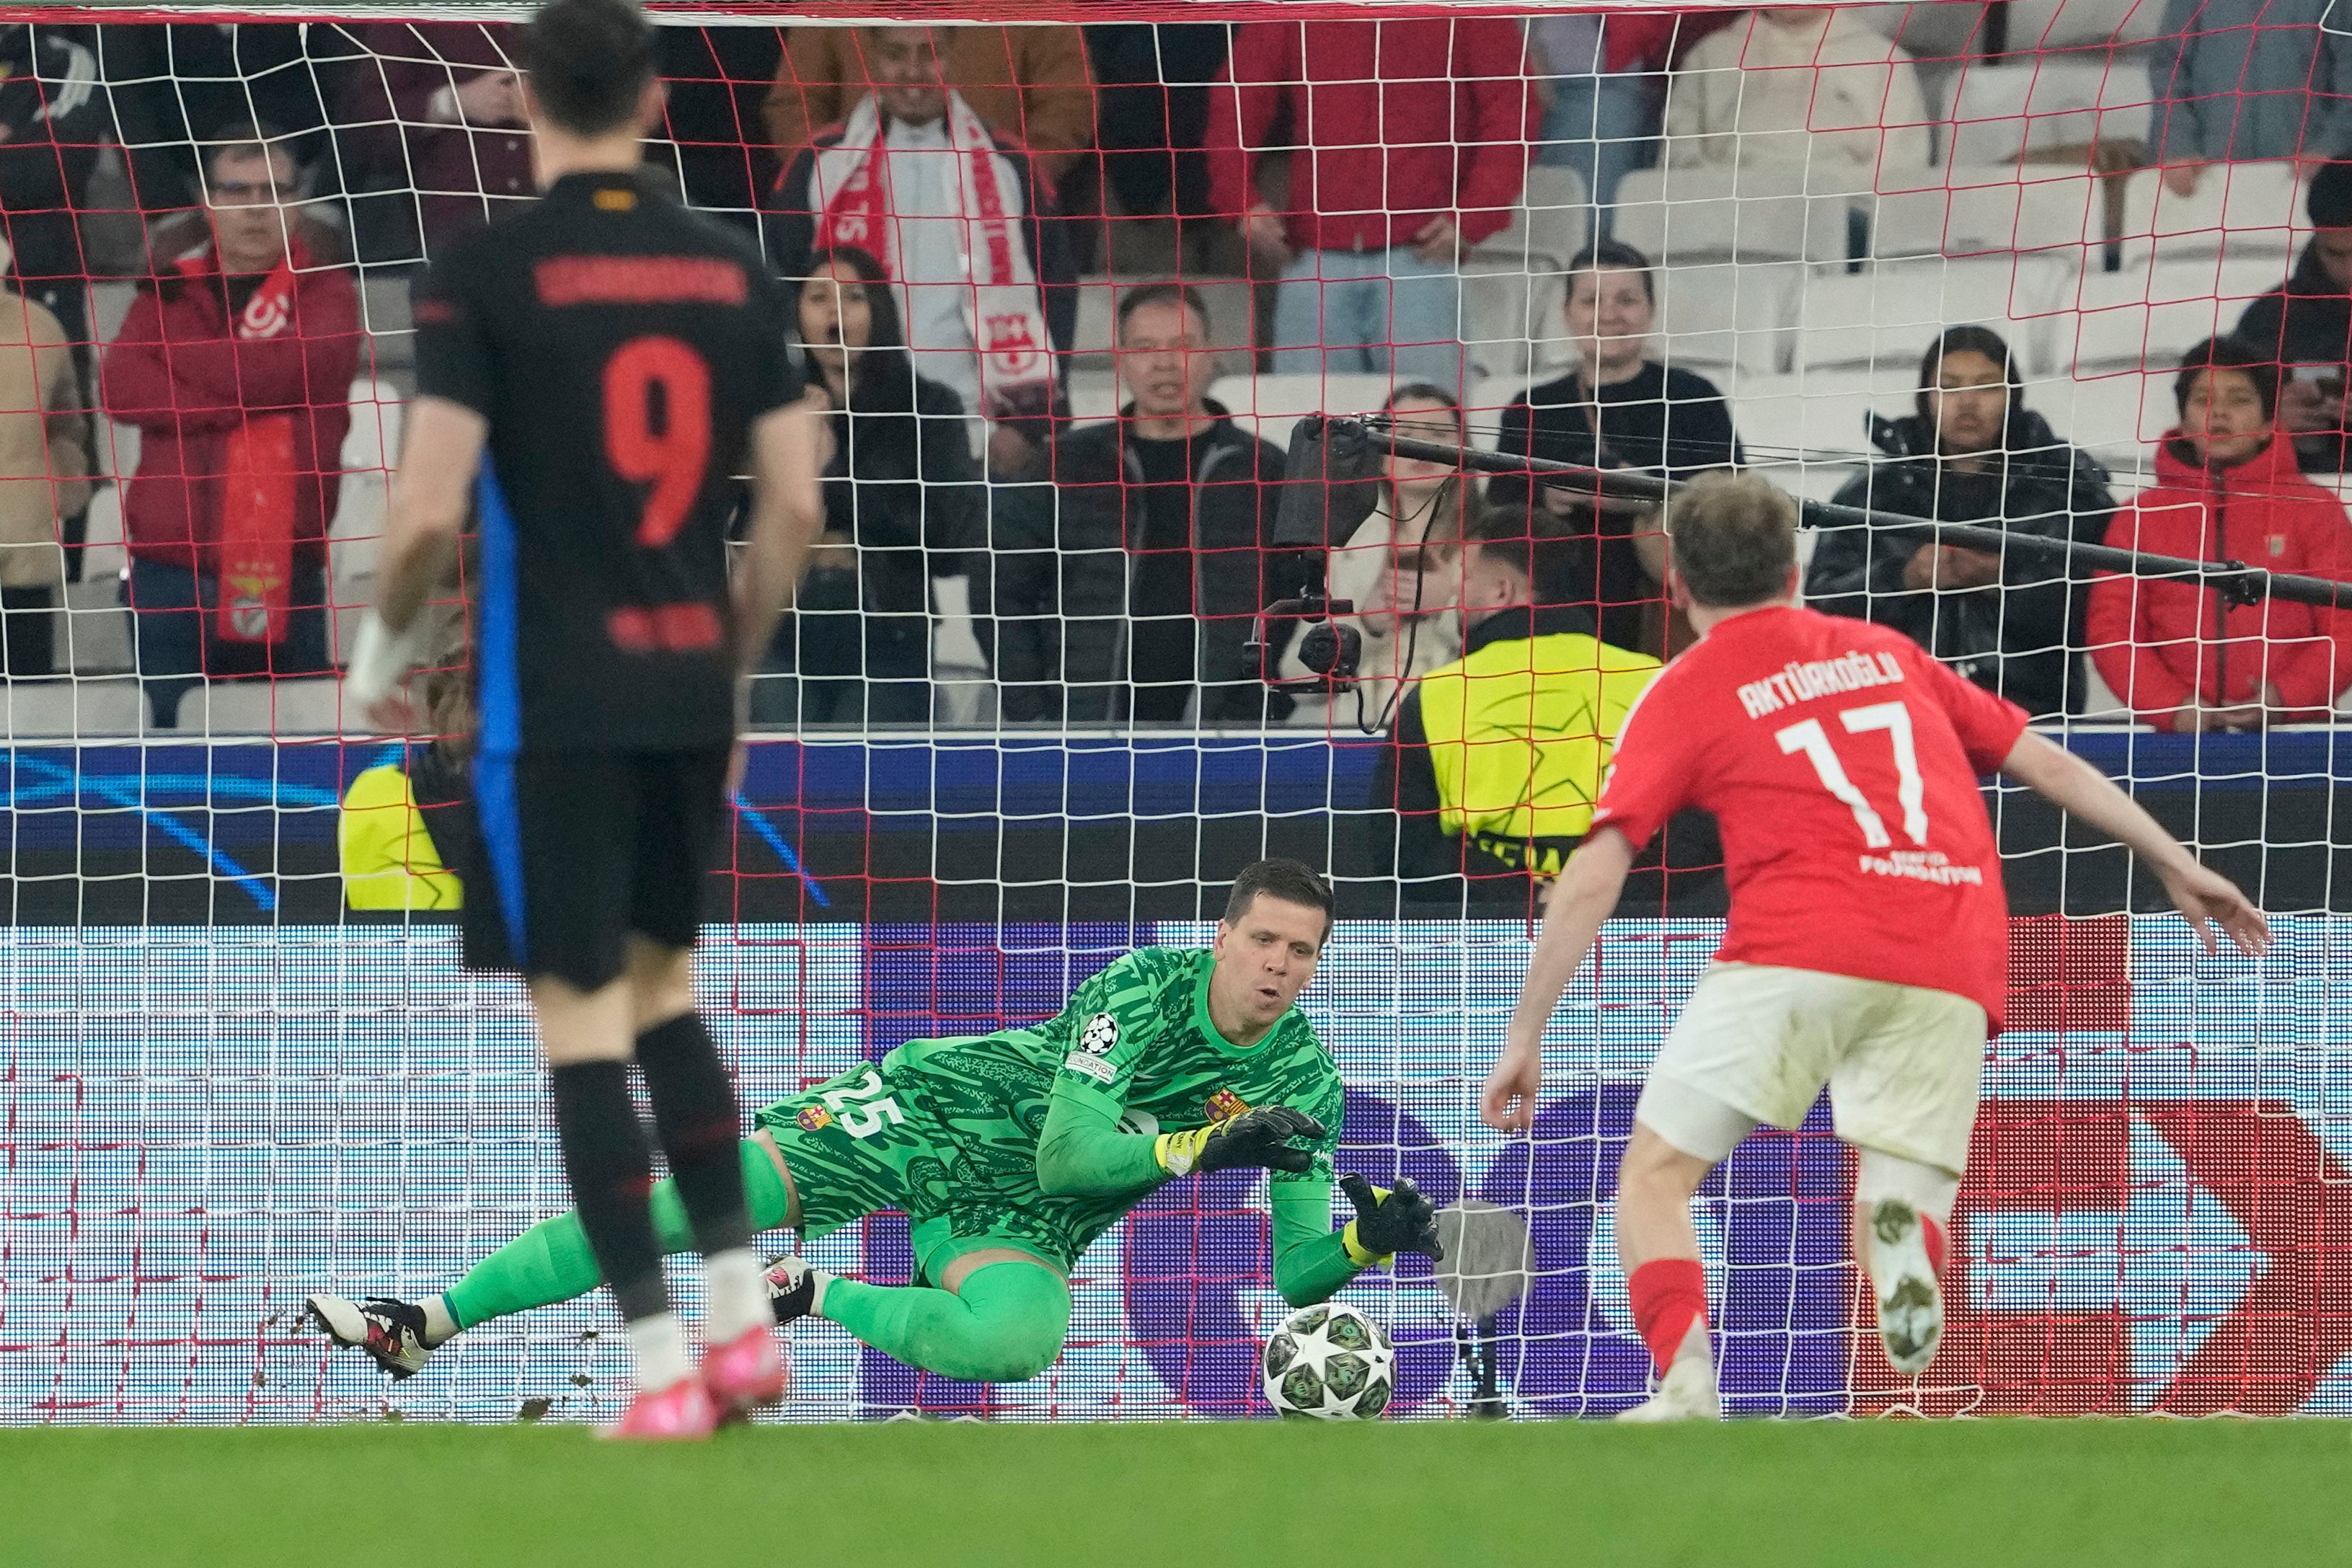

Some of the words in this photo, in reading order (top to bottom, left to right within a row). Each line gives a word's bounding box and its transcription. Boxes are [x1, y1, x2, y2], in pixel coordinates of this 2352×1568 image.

[601, 335, 712, 547] 9
[1736, 650, 1906, 720] AKTÜRKOĞLU
[1774, 700, 1929, 849] 17
[821, 1070, 906, 1139] 25
